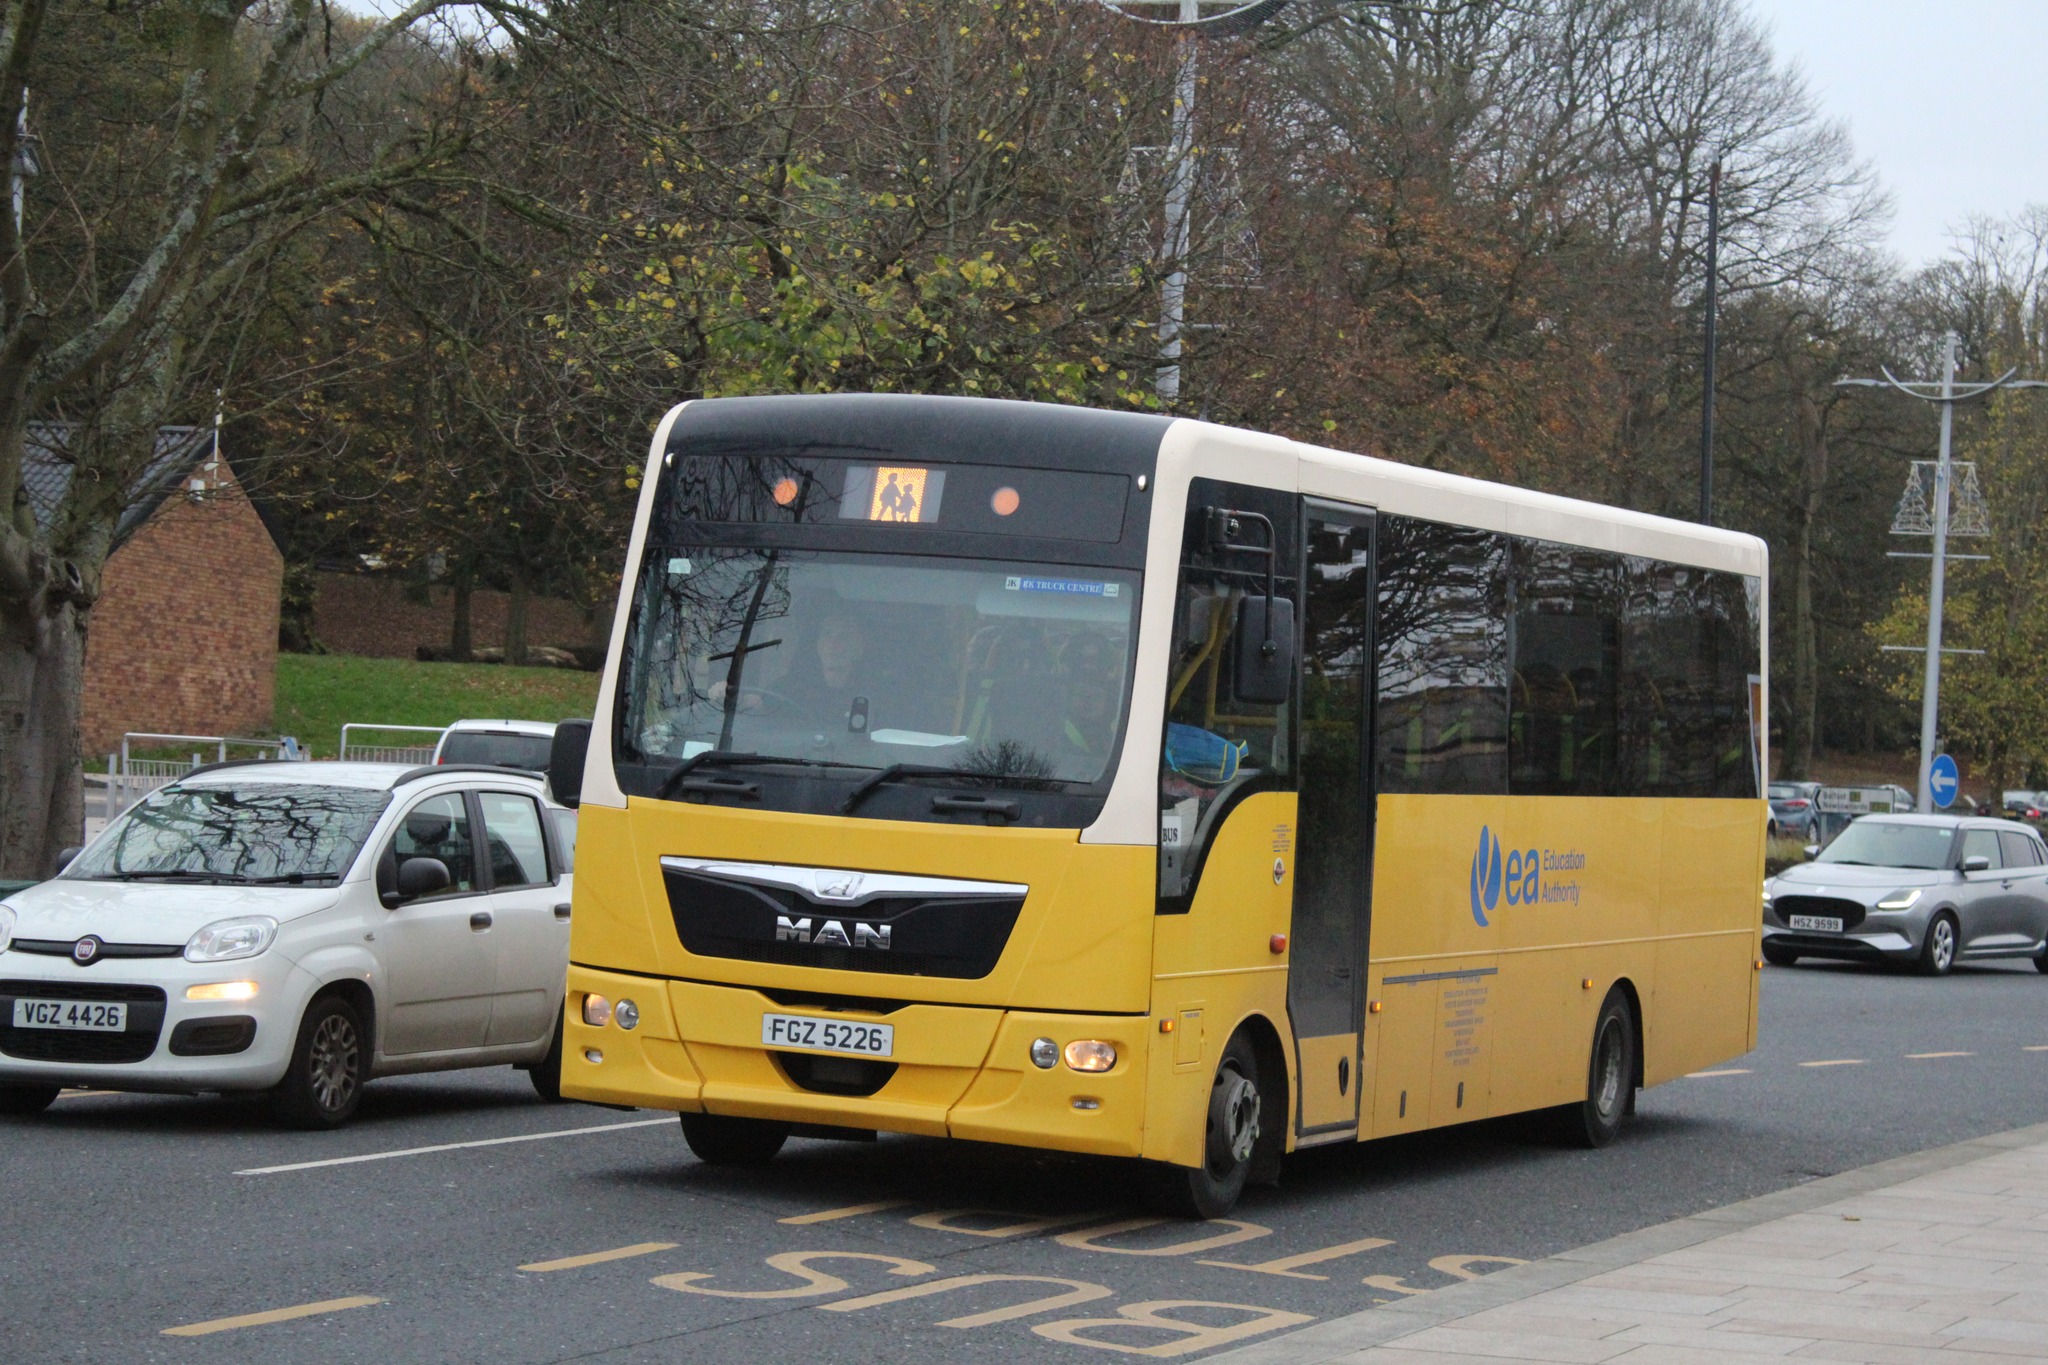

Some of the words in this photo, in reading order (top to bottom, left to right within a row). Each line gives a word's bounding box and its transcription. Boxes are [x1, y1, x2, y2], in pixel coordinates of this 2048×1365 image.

[1037, 581, 1065, 591] TRUCK
[1067, 583, 1101, 593] CENTRE
[1162, 827, 1178, 842] BUS
[1543, 848, 1585, 871] Education
[1505, 848, 1539, 906] ea
[1542, 880, 1580, 907] Authority
[776, 916, 892, 950] MAN
[1793, 917, 1812, 928] HSZ
[1814, 918, 1839, 930] 9599
[24, 1002, 61, 1024] VGZ
[67, 1004, 119, 1027] 4426
[771, 1018, 816, 1046] FGZ
[823, 1023, 883, 1052] 5226
[649, 1250, 1318, 1357] BUS
